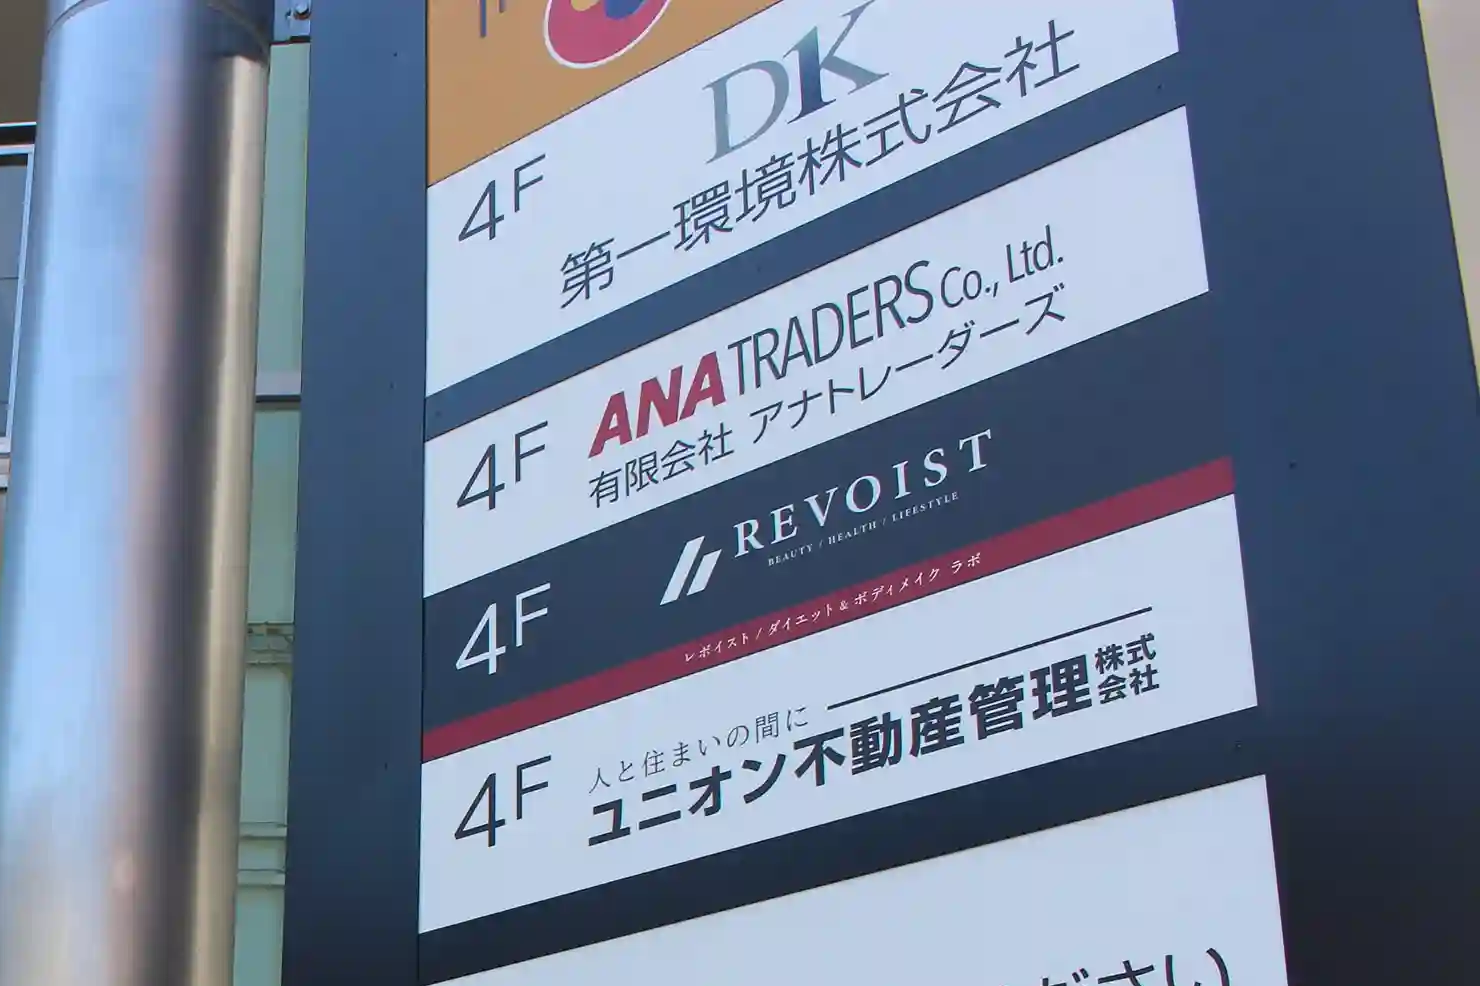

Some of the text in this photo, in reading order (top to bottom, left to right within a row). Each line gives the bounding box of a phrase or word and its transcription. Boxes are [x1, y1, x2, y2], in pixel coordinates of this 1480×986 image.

[703, 3, 889, 163] DK
[459, 154, 545, 241] 4F
[561, 20, 1079, 308] 第一環境株式会社
[588, 225, 1063, 458] ANA TRADERS Co., Ltd.
[589, 282, 1066, 508] 有限会社 アナトレーダーズ
[457, 421, 548, 508] 4F
[734, 429, 991, 557] REVOIST
[769, 545, 811, 566] BEAUTY
[829, 521, 876, 544] HEALTH
[893, 492, 958, 521] LIFESTYLE
[456, 583, 550, 670] 4F
[589, 707, 808, 793] 人と住まいの間に
[454, 755, 551, 841] 4F
